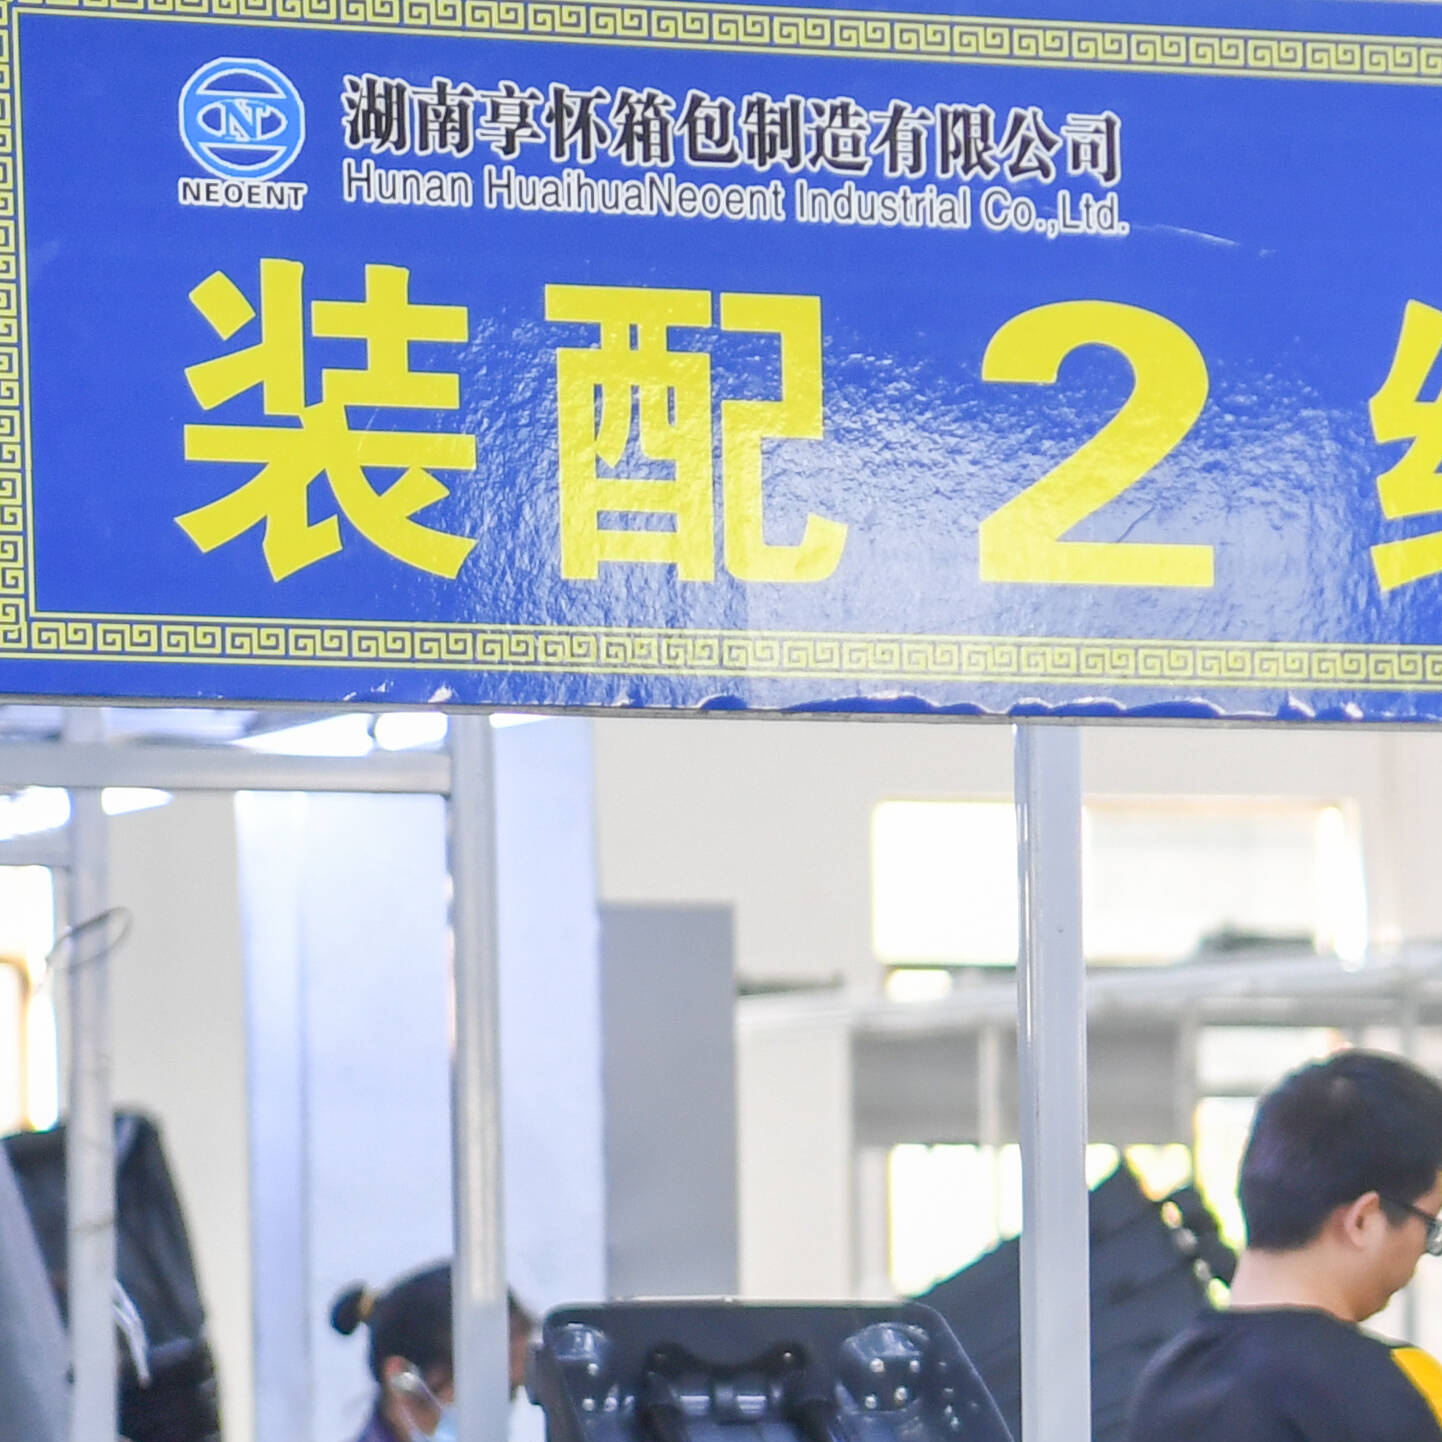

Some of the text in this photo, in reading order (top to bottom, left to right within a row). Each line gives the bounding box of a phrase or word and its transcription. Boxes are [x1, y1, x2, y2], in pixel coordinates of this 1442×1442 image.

[343, 75, 1119, 183] 湖南享怀箱包制造有限公司
[180, 179, 306, 208] NEOENT
[344, 160, 1130, 236] Hunan HuaihuaNeoent Industrial Co.,Ltd.
